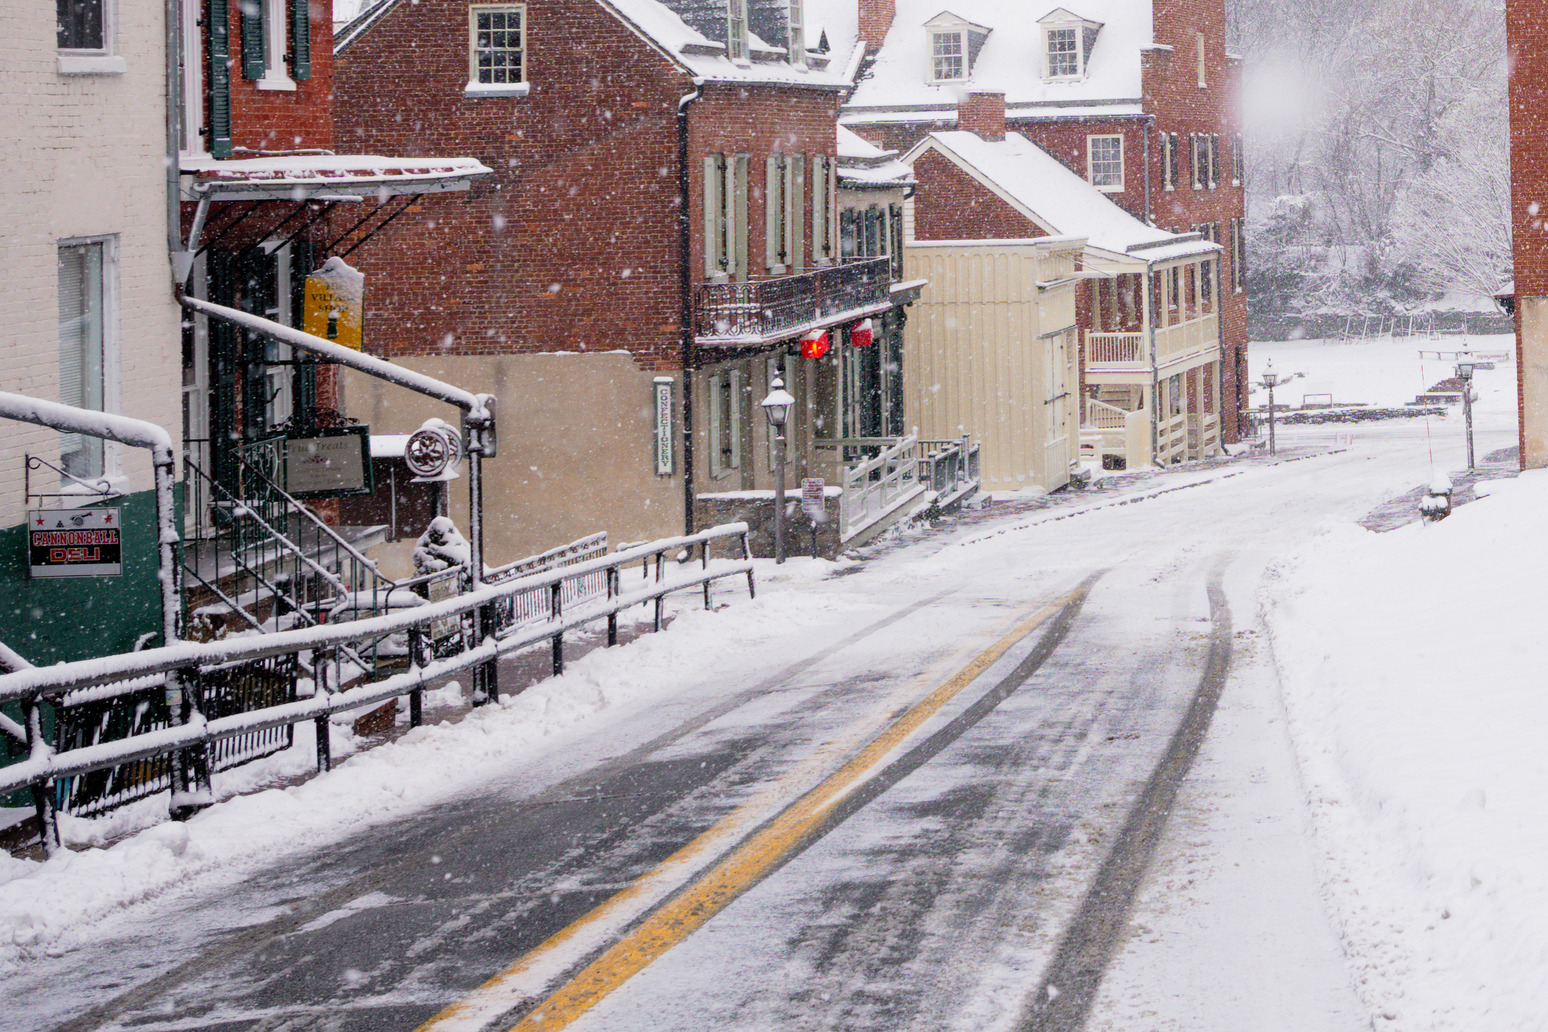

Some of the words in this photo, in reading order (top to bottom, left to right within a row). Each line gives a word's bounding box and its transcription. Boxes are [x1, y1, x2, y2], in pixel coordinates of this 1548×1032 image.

[660, 388, 669, 467] CONFECTIONERY
[316, 440, 348, 450] Treats
[32, 529, 119, 546] CANNONBALL
[50, 547, 101, 562] DELI
